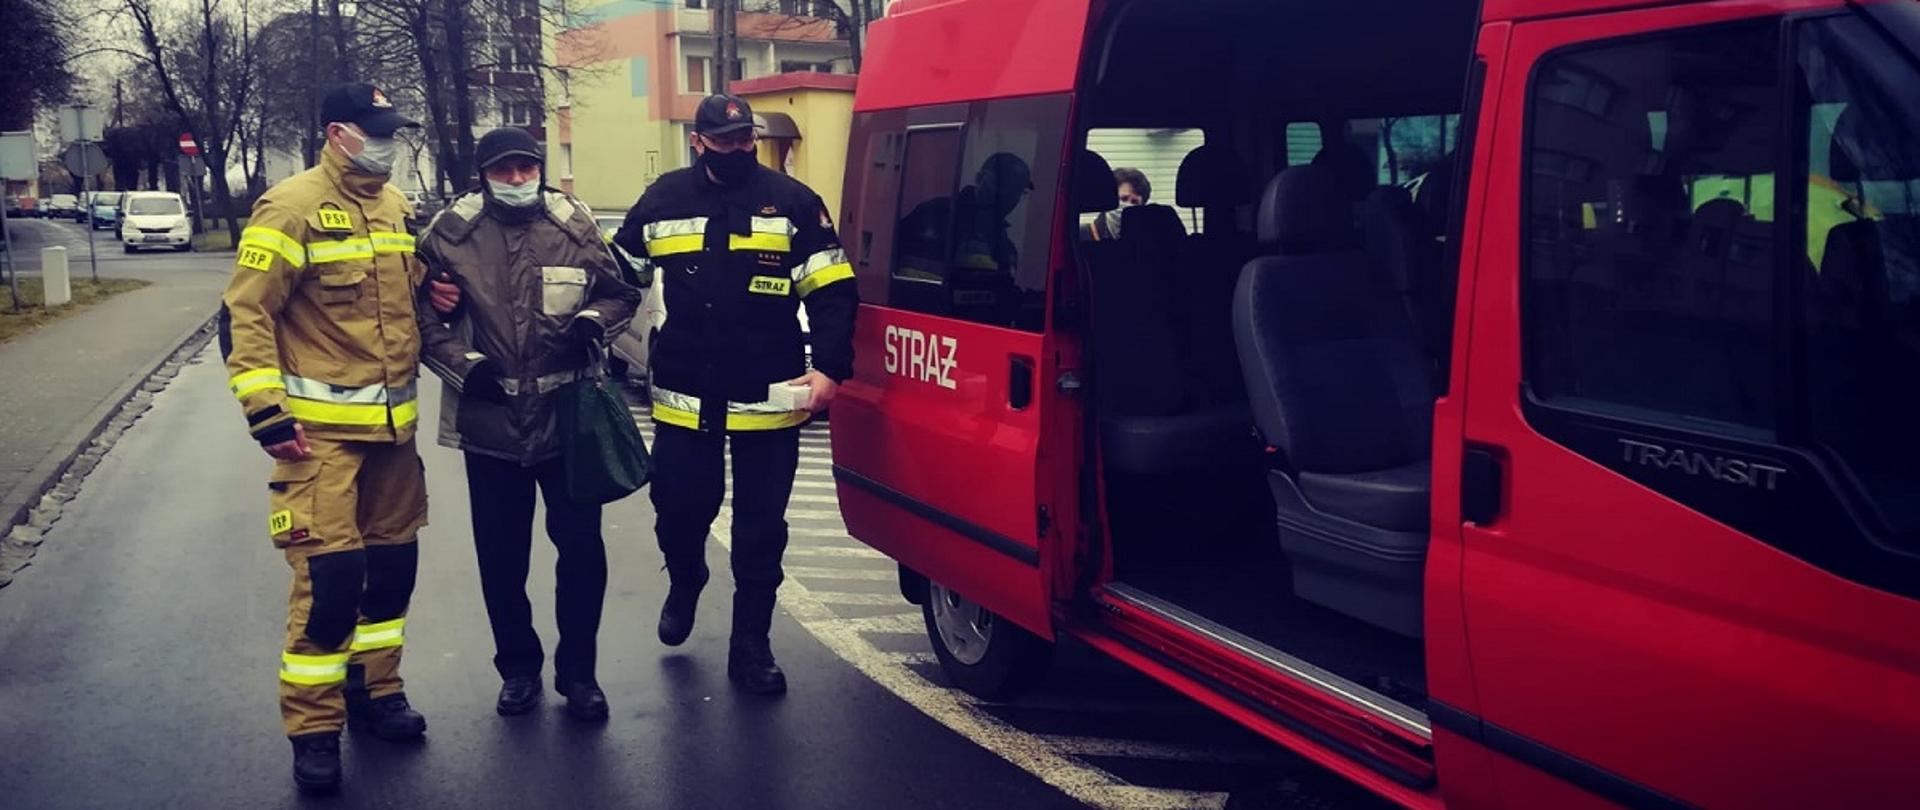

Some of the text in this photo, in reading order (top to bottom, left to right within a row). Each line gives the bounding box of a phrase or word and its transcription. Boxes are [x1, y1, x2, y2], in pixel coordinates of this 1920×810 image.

[325, 213, 346, 225] PSP
[244, 250, 267, 265] PSP
[1618, 438, 1787, 490] TRANSIT
